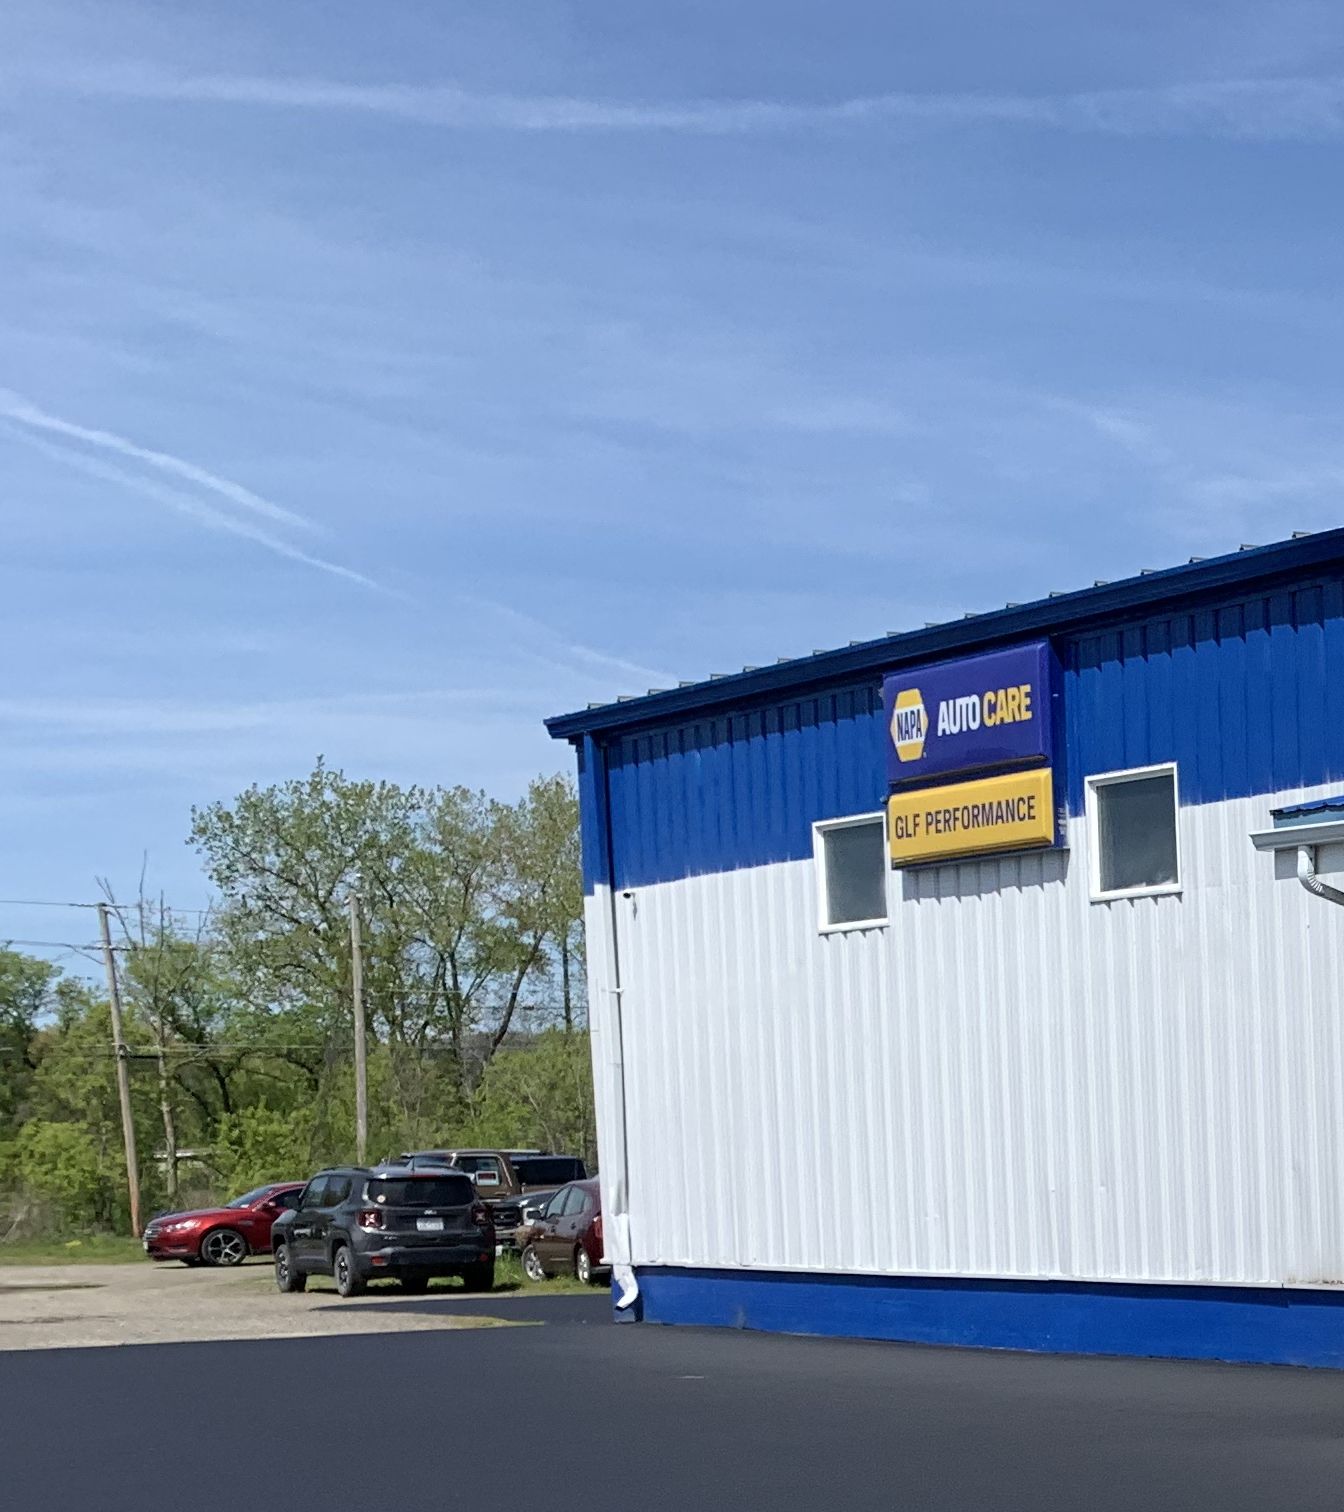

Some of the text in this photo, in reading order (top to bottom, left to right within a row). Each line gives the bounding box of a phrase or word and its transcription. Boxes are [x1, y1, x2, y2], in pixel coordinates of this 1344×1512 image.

[897, 684, 1032, 742] NAPA AUTO CARE
[895, 795, 1036, 840] GLF PERFORMANCE
